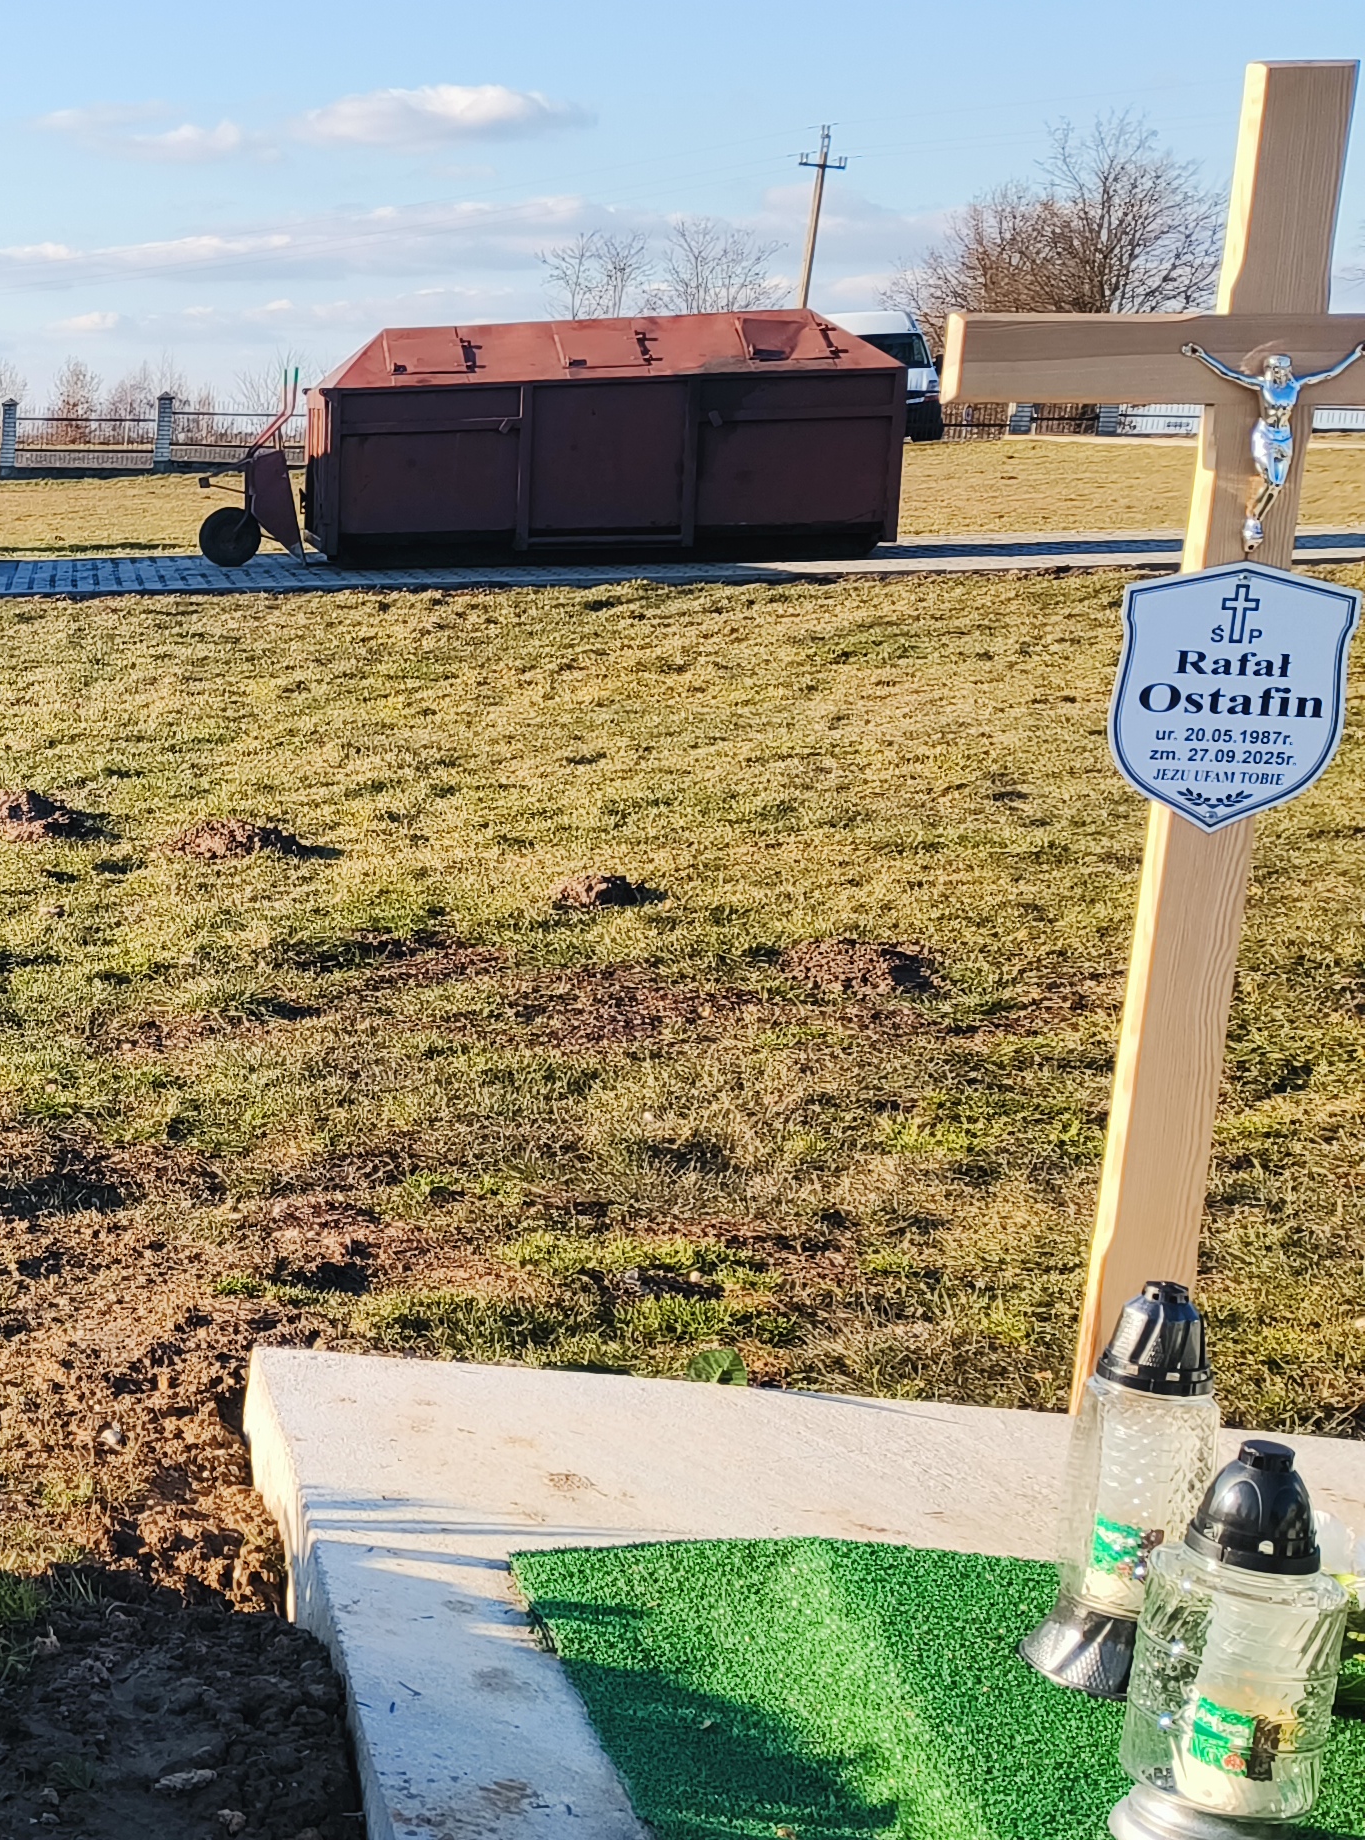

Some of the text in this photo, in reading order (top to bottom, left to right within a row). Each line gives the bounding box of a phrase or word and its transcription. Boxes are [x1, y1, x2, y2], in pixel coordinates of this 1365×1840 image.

[1210, 624, 1263, 644] Ś P
[1173, 649, 1293, 678] Rafał
[1138, 682, 1324, 718] Ostafin
[1155, 727, 1293, 746] ur. 20.05.1987r.
[1149, 748, 1297, 766] zm. 27.09.2025r.
[1152, 768, 1286, 786] JEZU UFAM TOBIE
